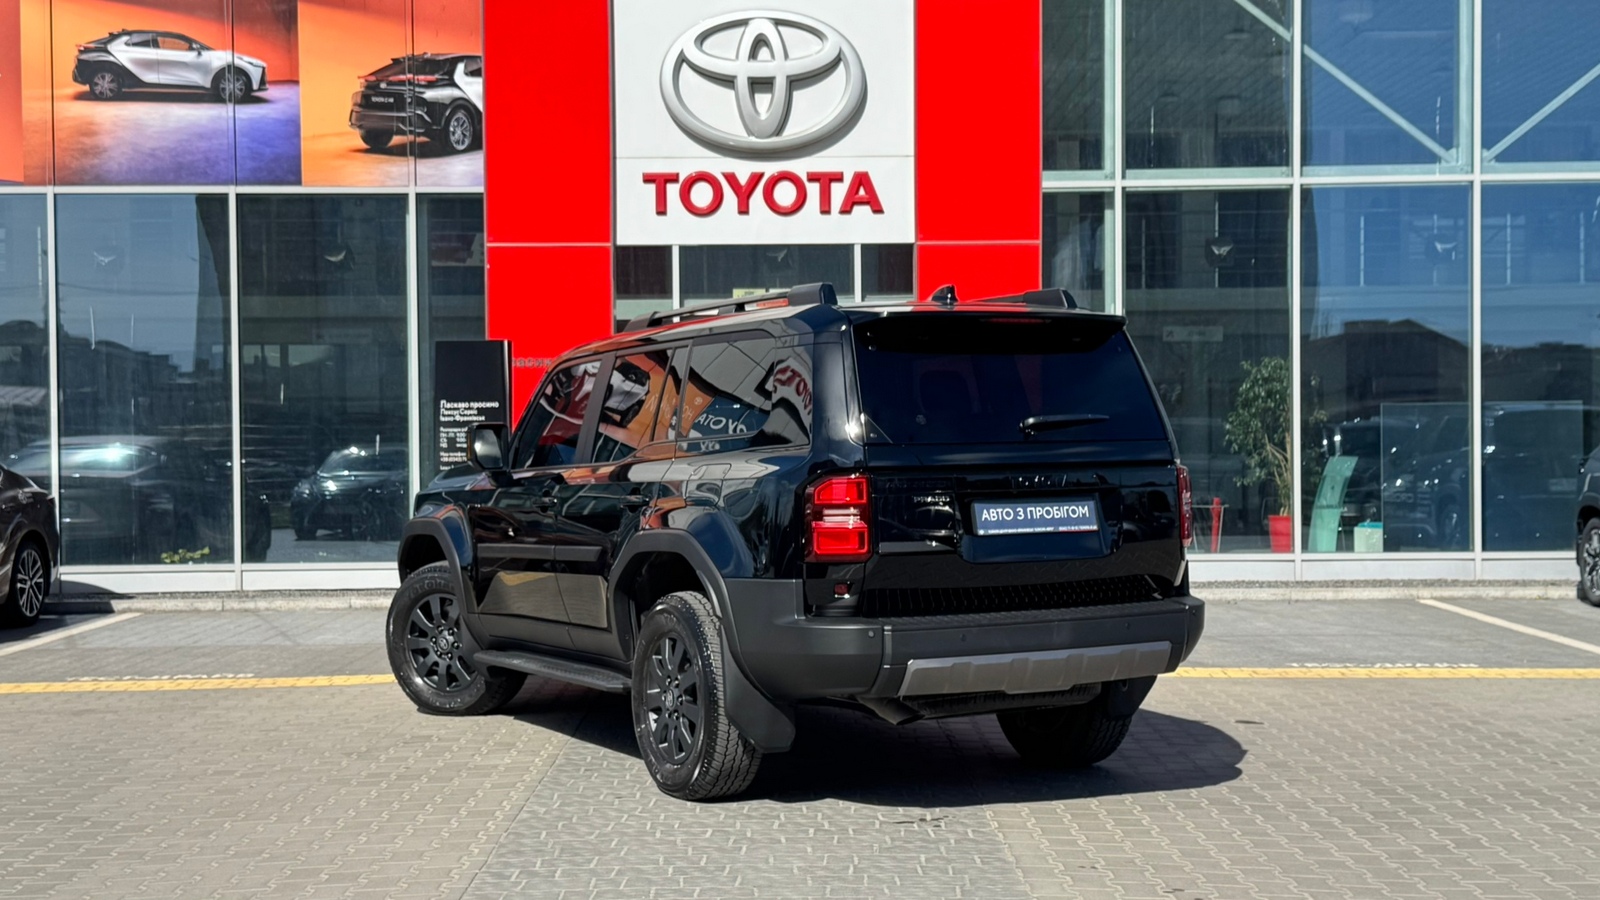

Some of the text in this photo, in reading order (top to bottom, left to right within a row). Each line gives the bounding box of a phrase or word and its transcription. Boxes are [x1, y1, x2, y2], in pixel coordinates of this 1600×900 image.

[642, 170, 885, 217] TOYOTA
[440, 400, 499, 409] Ласкаво просимо
[981, 505, 1090, 521] АВТО З ПРОБІГОМ
